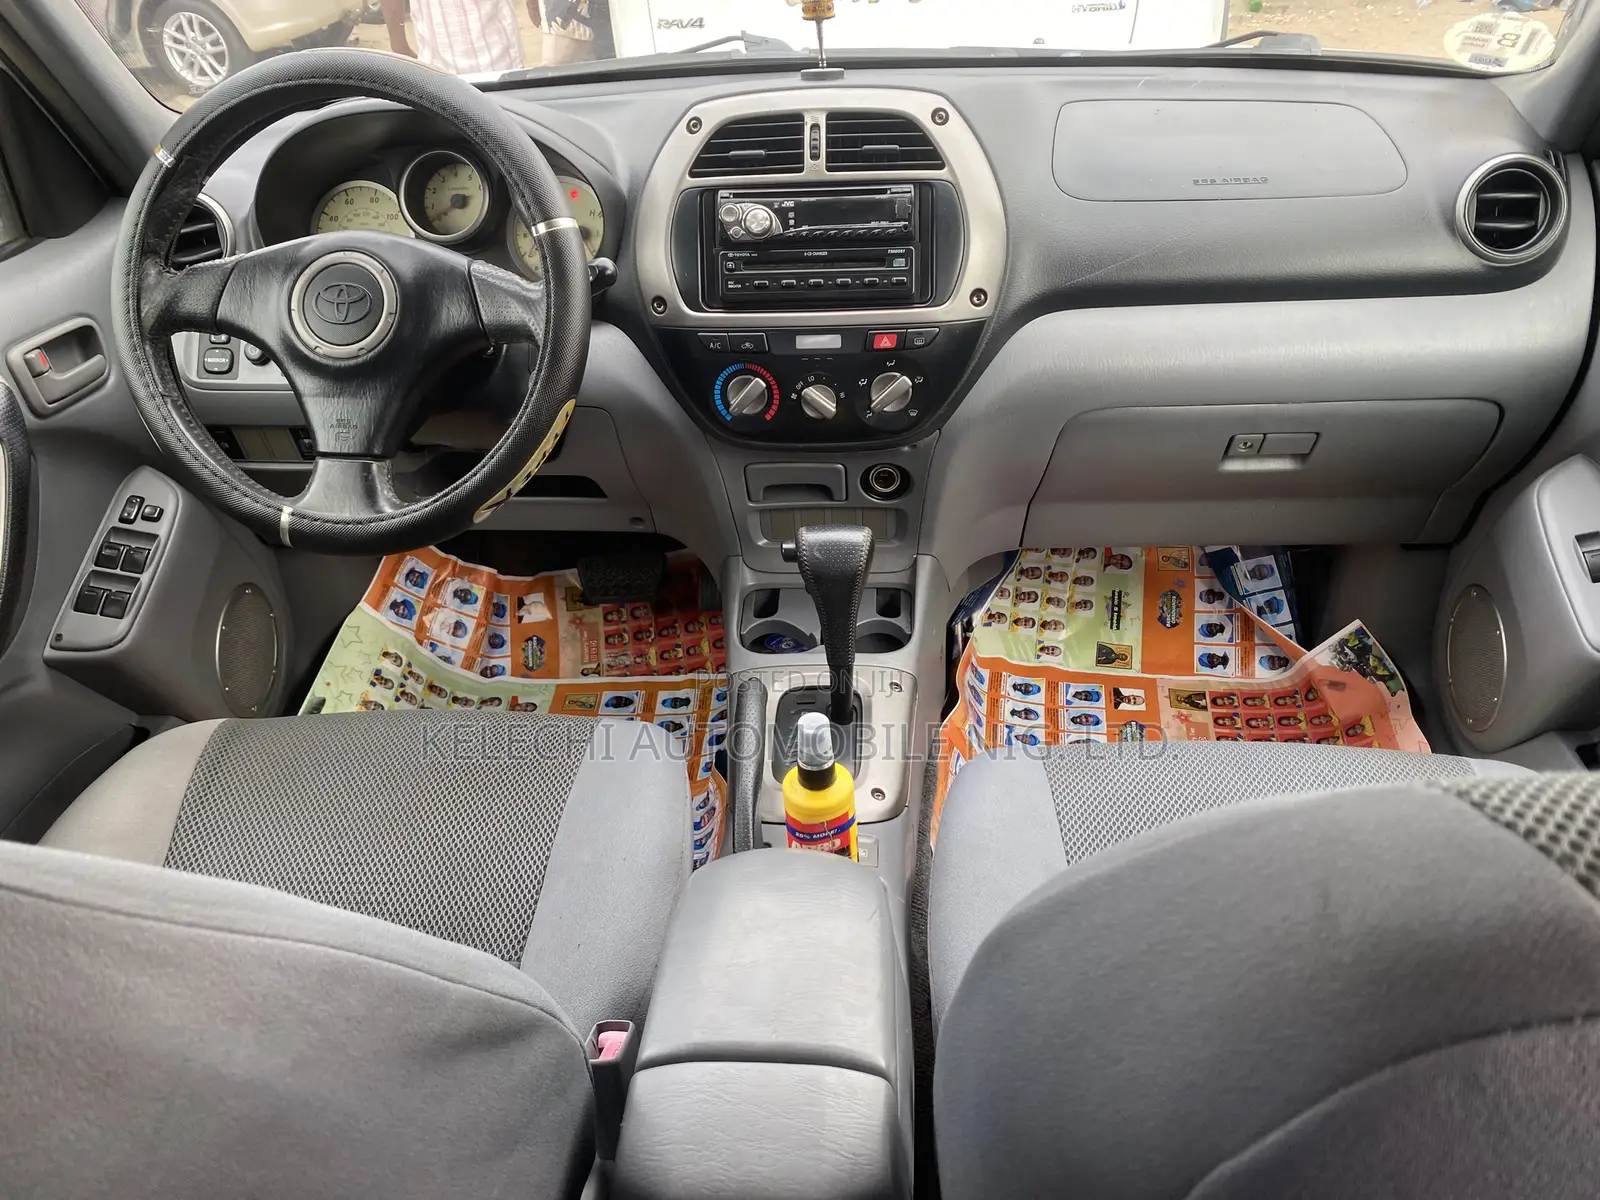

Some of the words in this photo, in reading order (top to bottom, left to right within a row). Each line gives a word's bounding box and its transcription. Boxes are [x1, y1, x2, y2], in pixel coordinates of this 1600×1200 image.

[657, 17, 705, 29] RAV4
[369, 196, 380, 204] 80
[807, 375, 816, 383] LO
[795, 380, 805, 391] OFF
